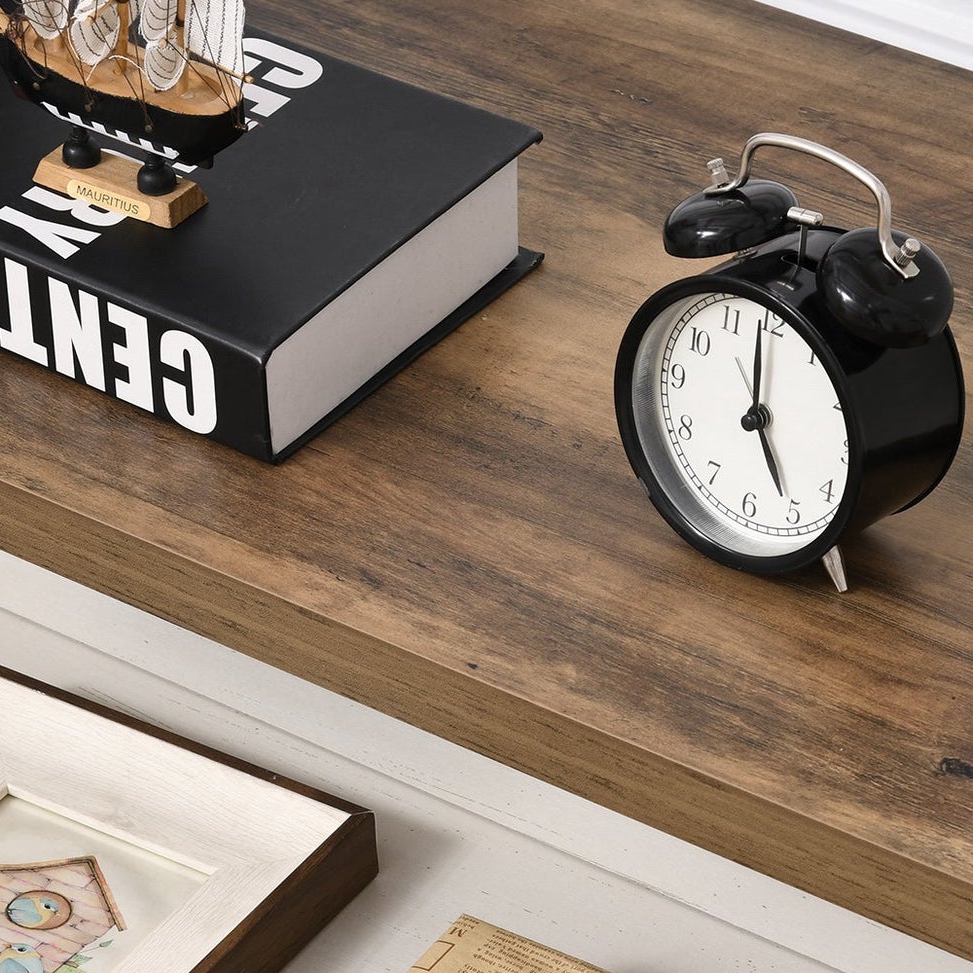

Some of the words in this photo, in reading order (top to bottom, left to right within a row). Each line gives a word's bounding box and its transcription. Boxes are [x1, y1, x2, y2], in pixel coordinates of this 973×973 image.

[75, 184, 140, 216] MAURITIUS
[721, 305, 740, 336] 11
[761, 309, 787, 338] 12
[689, 326, 711, 357] 10
[671, 363, 686, 389] 9
[678, 414, 693, 441] 8
[706, 460, 722, 485] 7
[819, 478, 836, 503] 4
[742, 492, 757, 518] 6
[785, 498, 801, 524] 5
